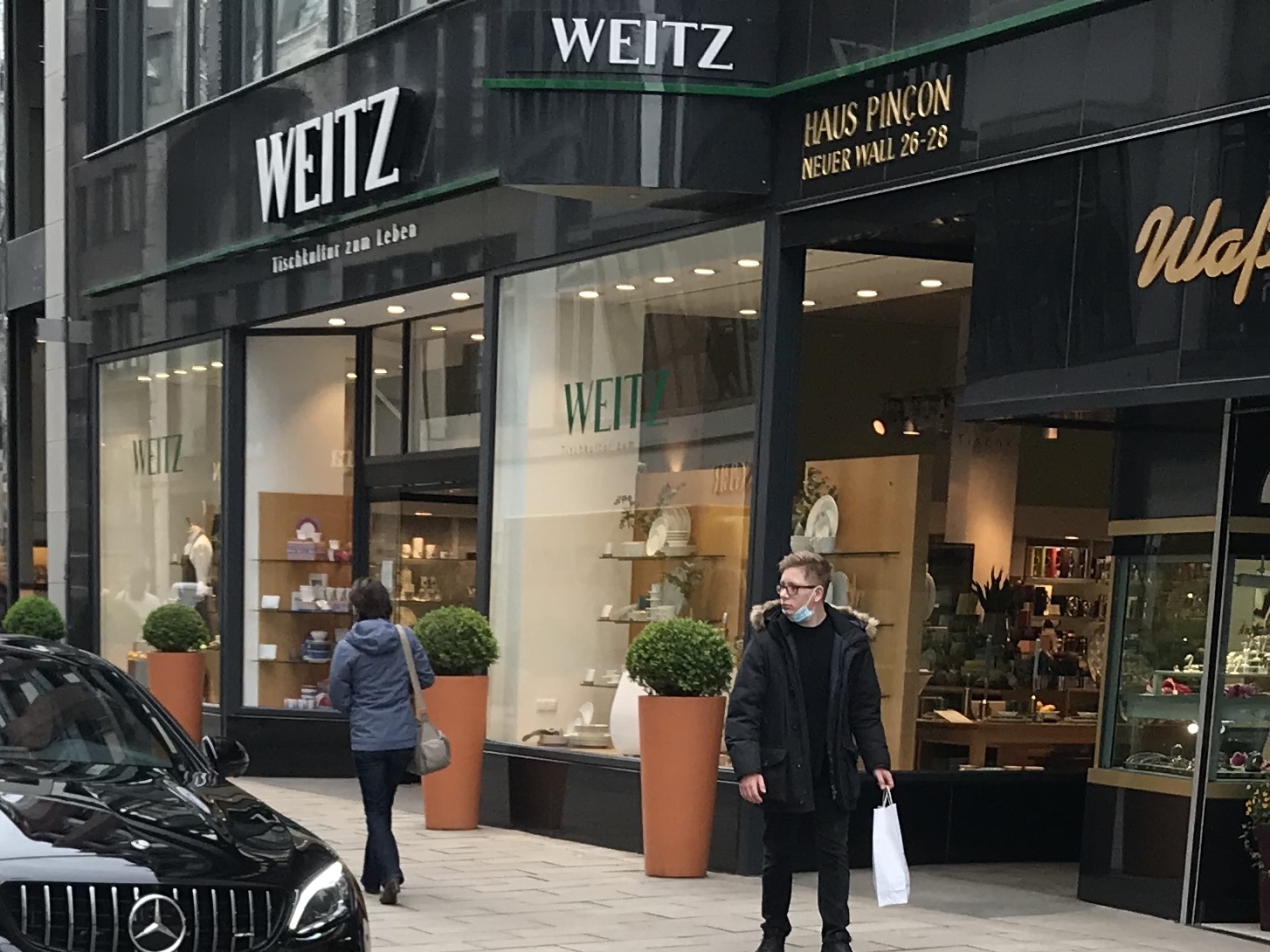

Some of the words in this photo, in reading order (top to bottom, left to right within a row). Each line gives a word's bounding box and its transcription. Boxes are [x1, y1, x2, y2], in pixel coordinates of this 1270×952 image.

[551, 17, 734, 71] WEITZ
[804, 101, 858, 147] HAUS
[865, 74, 952, 132] PINÇON
[255, 86, 401, 223] WEITZ
[801, 148, 851, 180] NEUER
[855, 137, 896, 167] WALL
[900, 125, 949, 157] 26-28
[272, 243, 340, 273] Tischkultur
[345, 236, 371, 255] zum
[376, 223, 418, 247] Leben
[563, 369, 670, 436] WEITZ
[132, 433, 183, 476] WEITZ
